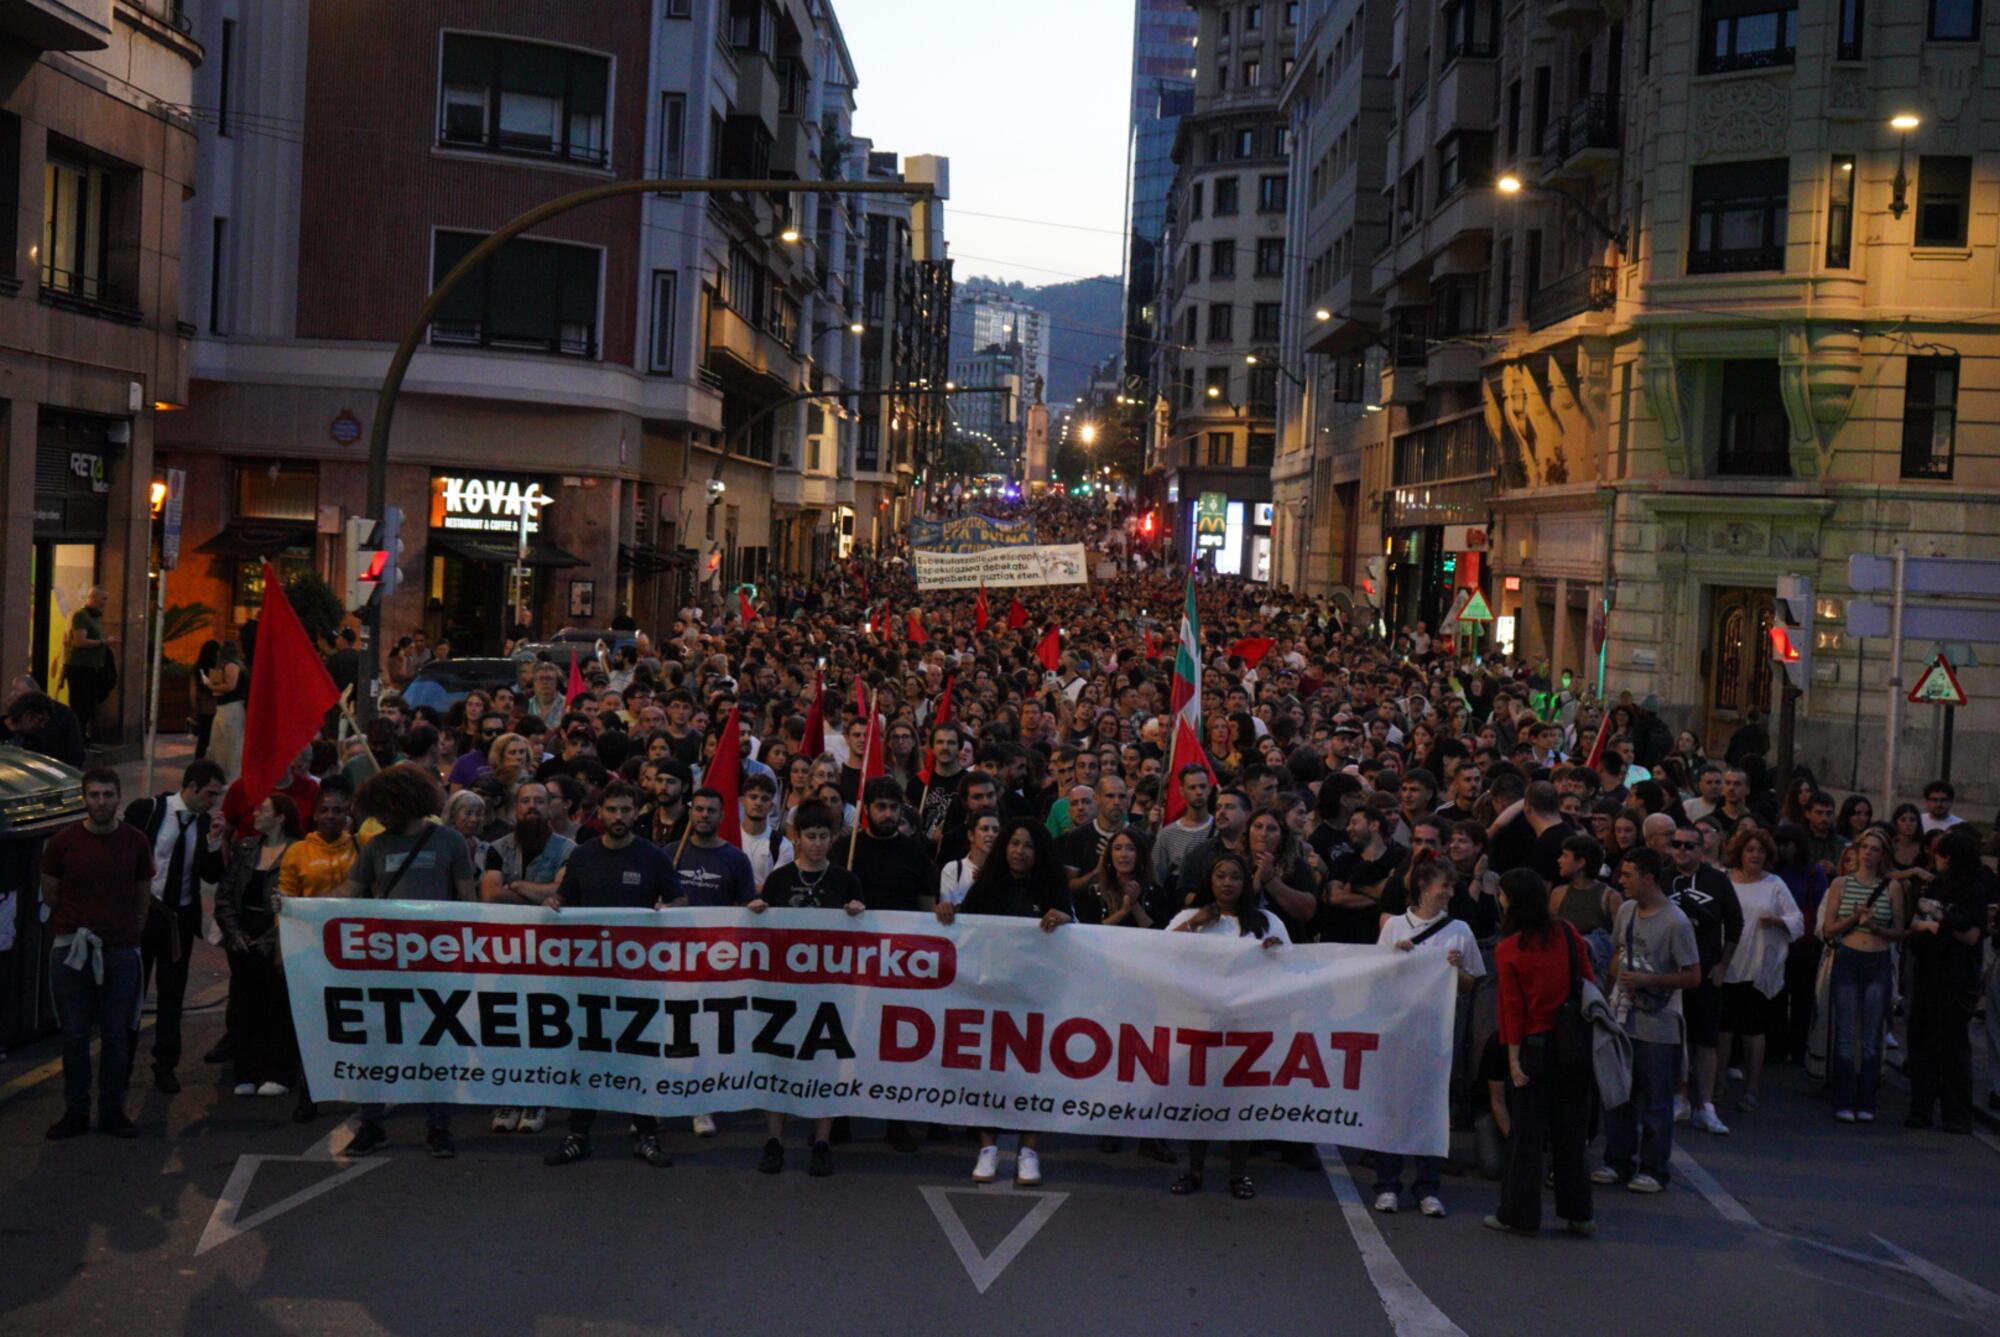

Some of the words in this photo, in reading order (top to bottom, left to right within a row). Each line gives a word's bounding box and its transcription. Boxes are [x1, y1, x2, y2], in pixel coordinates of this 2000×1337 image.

[445, 518, 483, 529] RESTAURANT
[446, 478, 540, 517] KOVAC
[339, 922, 770, 972] Espekulazioaren
[785, 938, 940, 979] aurka
[323, 986, 856, 1061] ETXEBIZITZA
[878, 1004, 1379, 1090] DENONTZAT
[333, 1060, 485, 1083] Etxegabetze
[492, 1065, 581, 1086] guztiak
[588, 1070, 648, 1095] eten,
[656, 1070, 863, 1099] espekulatzaileak
[869, 1082, 1007, 1109] espropiatu
[1014, 1095, 1054, 1113] eta
[1062, 1098, 1232, 1123] espekulazioa
[1238, 1103, 1364, 1128] debekatu.
